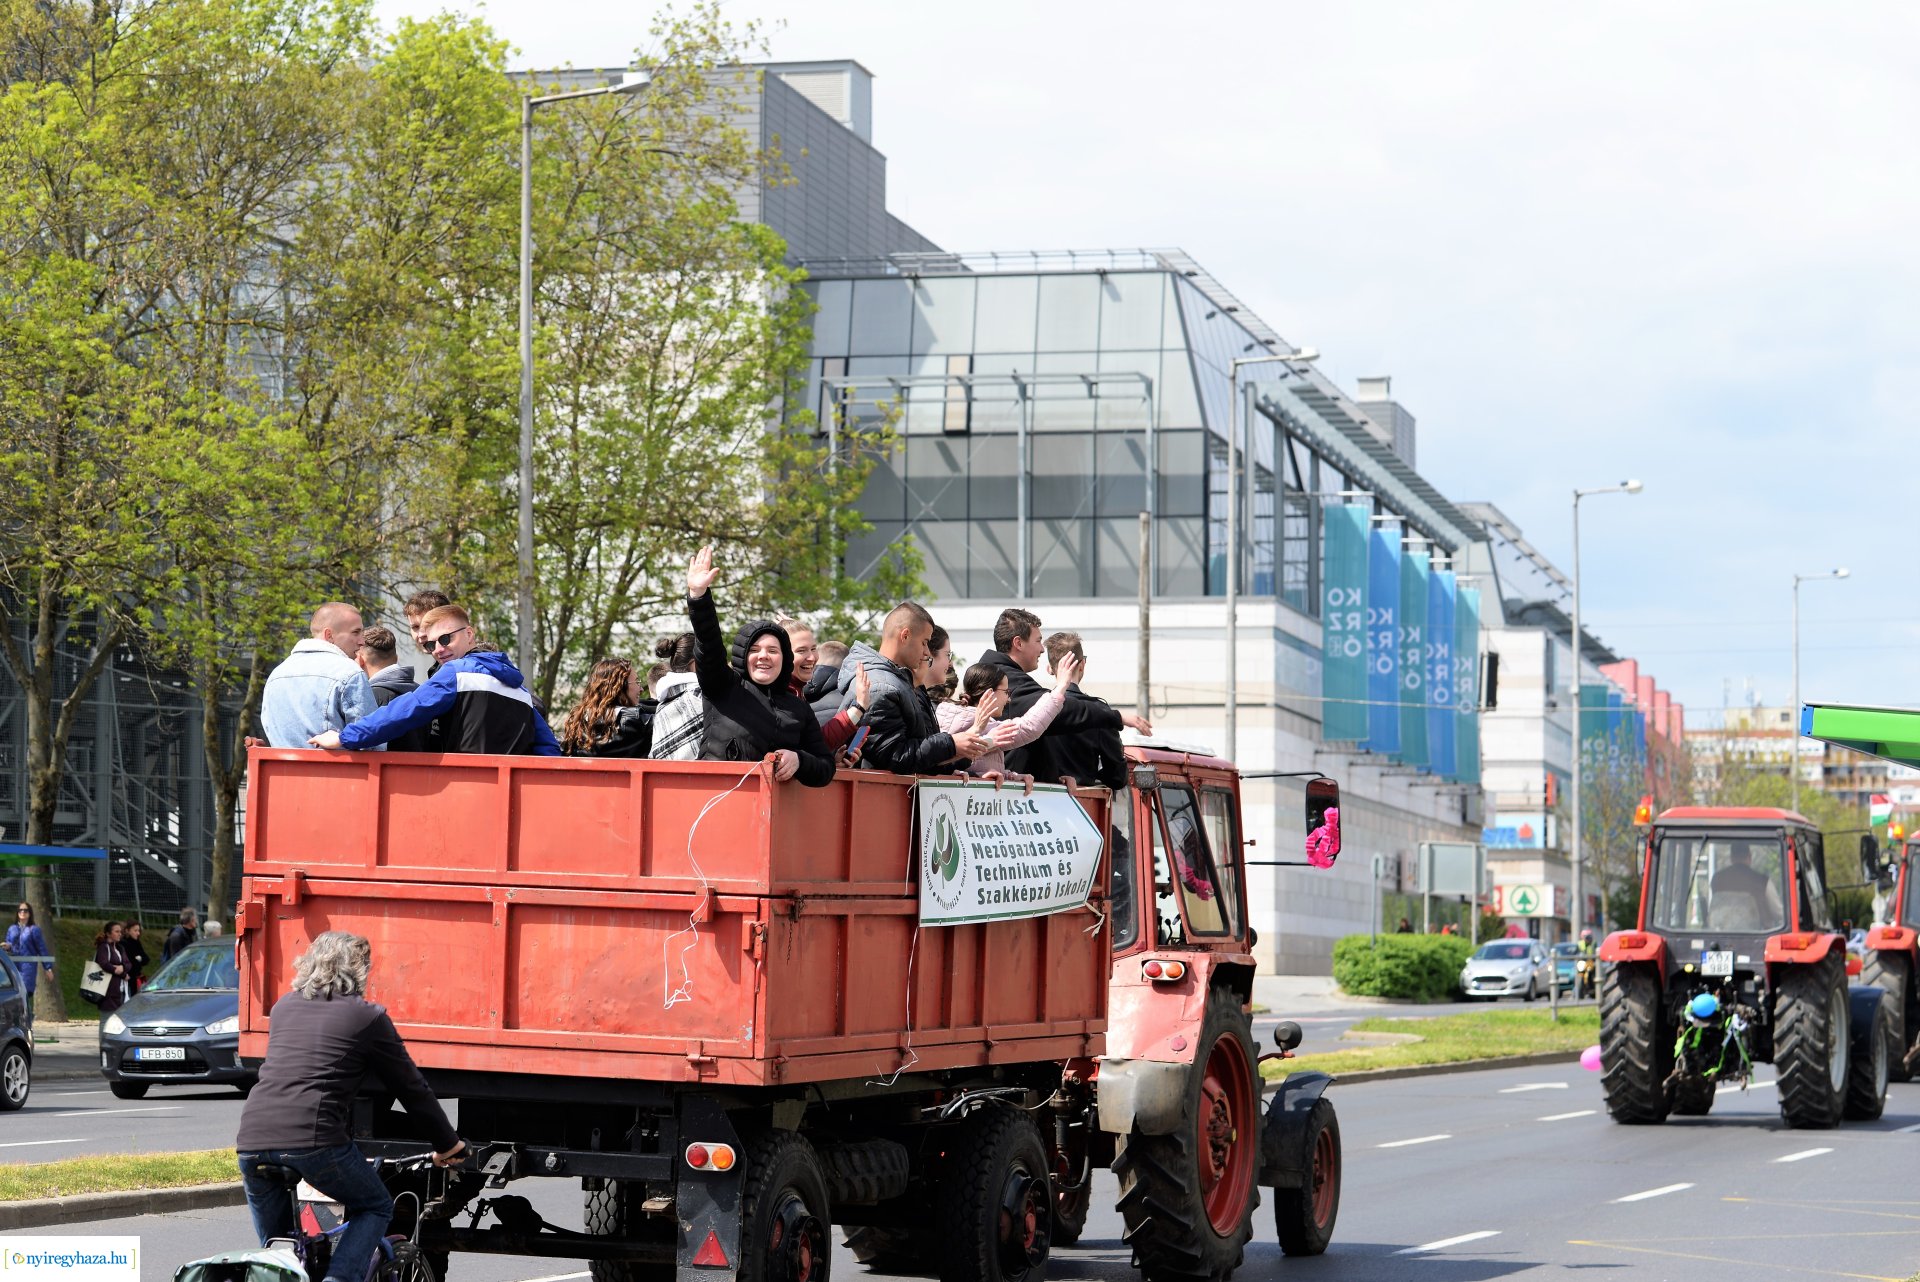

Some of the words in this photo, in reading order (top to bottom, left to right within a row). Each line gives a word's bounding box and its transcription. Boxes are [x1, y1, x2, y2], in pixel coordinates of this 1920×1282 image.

[966, 795, 1002, 816] Északi
[1007, 799, 1039, 816] ASzC
[965, 820, 1009, 840] Lippai
[1011, 819, 1053, 837] János
[971, 836, 1080, 860] Mezőgazdasági
[975, 862, 1053, 883] Technikum
[1058, 859, 1072, 876] és
[977, 882, 1051, 906] Szakképző
[1054, 878, 1087, 898] Iskola
